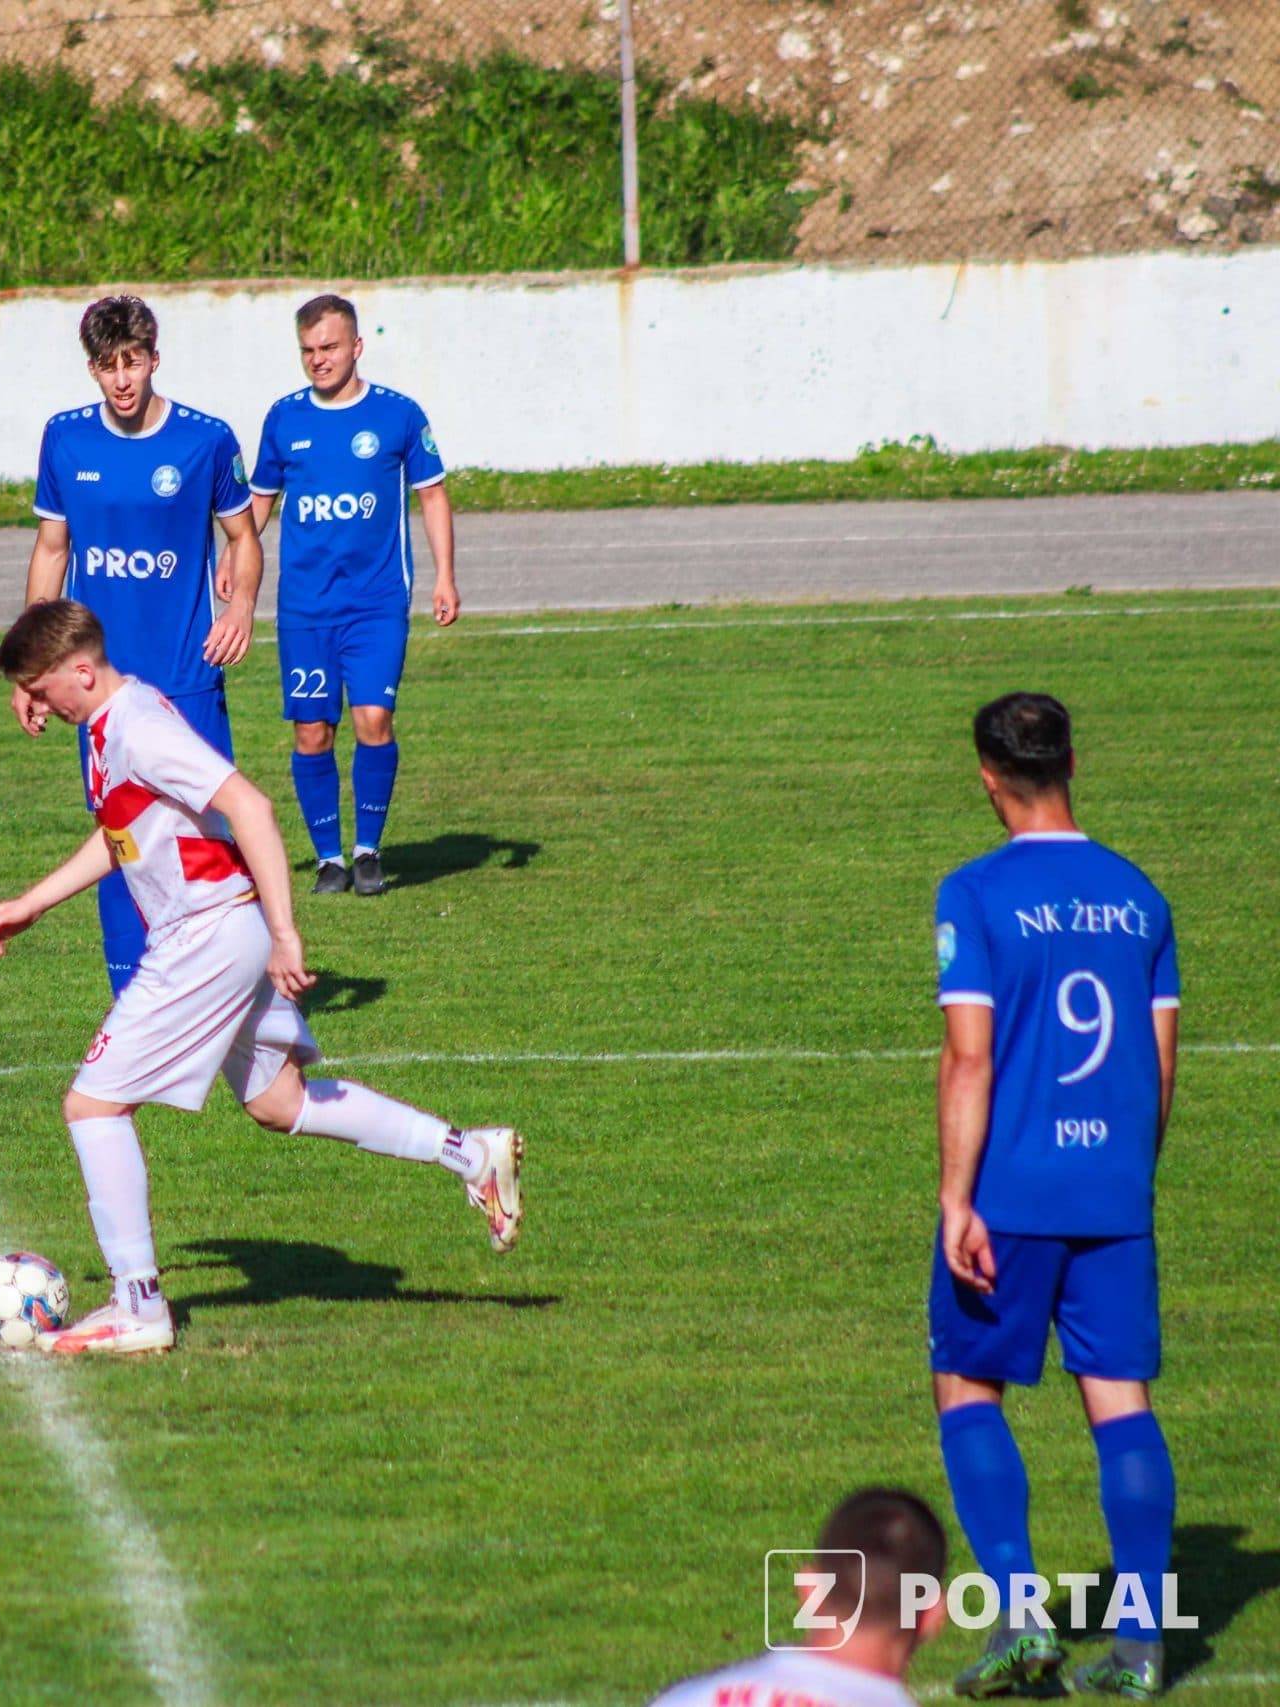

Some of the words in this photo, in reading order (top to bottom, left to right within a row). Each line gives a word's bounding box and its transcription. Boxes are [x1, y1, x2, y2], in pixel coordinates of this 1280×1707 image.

[76, 471, 100, 481] JAKO
[298, 492, 377, 522] PRO9
[86, 546, 178, 579] PRO9
[290, 668, 328, 698] 22
[312, 814, 337, 826] JAKO
[360, 803, 387, 812] JAKO
[1015, 903, 1063, 938] NK
[1068, 897, 1149, 938] ŽEPČE
[1057, 970, 1114, 1084] 9
[1055, 1118, 1108, 1148] 1919
